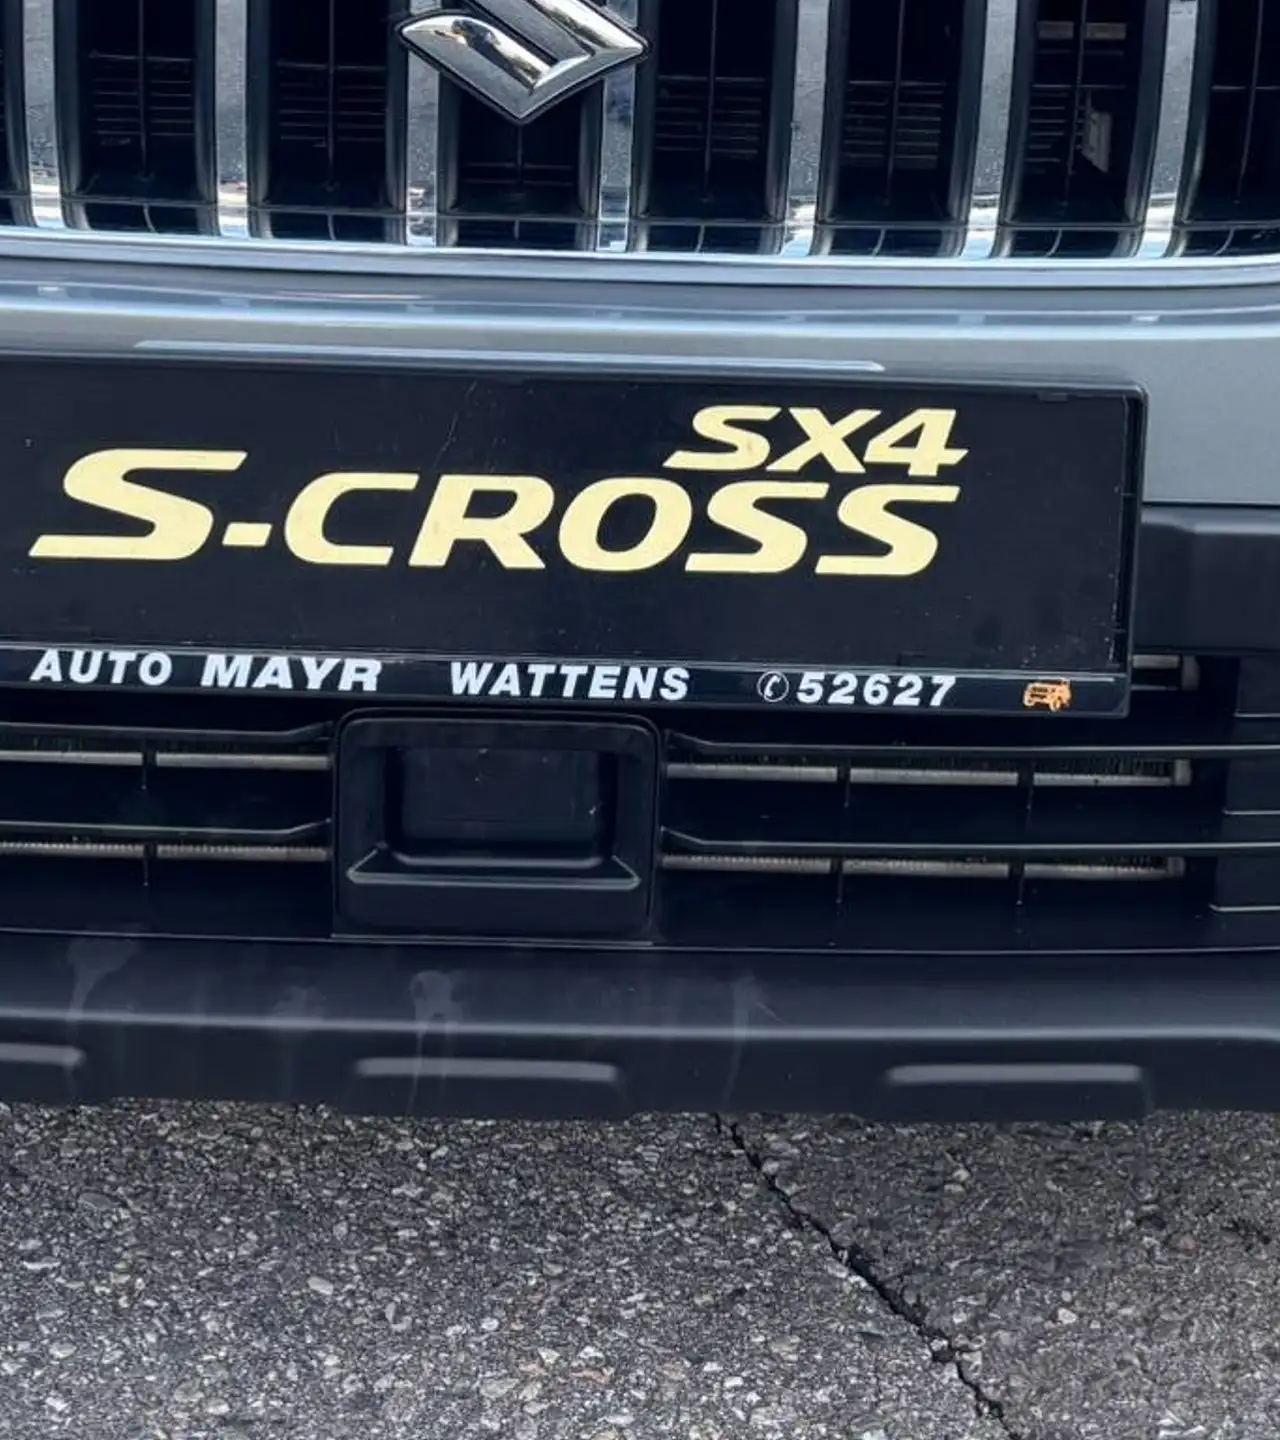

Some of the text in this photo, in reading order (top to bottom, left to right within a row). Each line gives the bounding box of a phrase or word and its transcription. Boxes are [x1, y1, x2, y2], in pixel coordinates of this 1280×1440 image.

[661, 404, 970, 477] SX4
[27, 447, 961, 578] S-CROSS
[29, 648, 957, 708] AUTO MAYR WATTENS 52627
